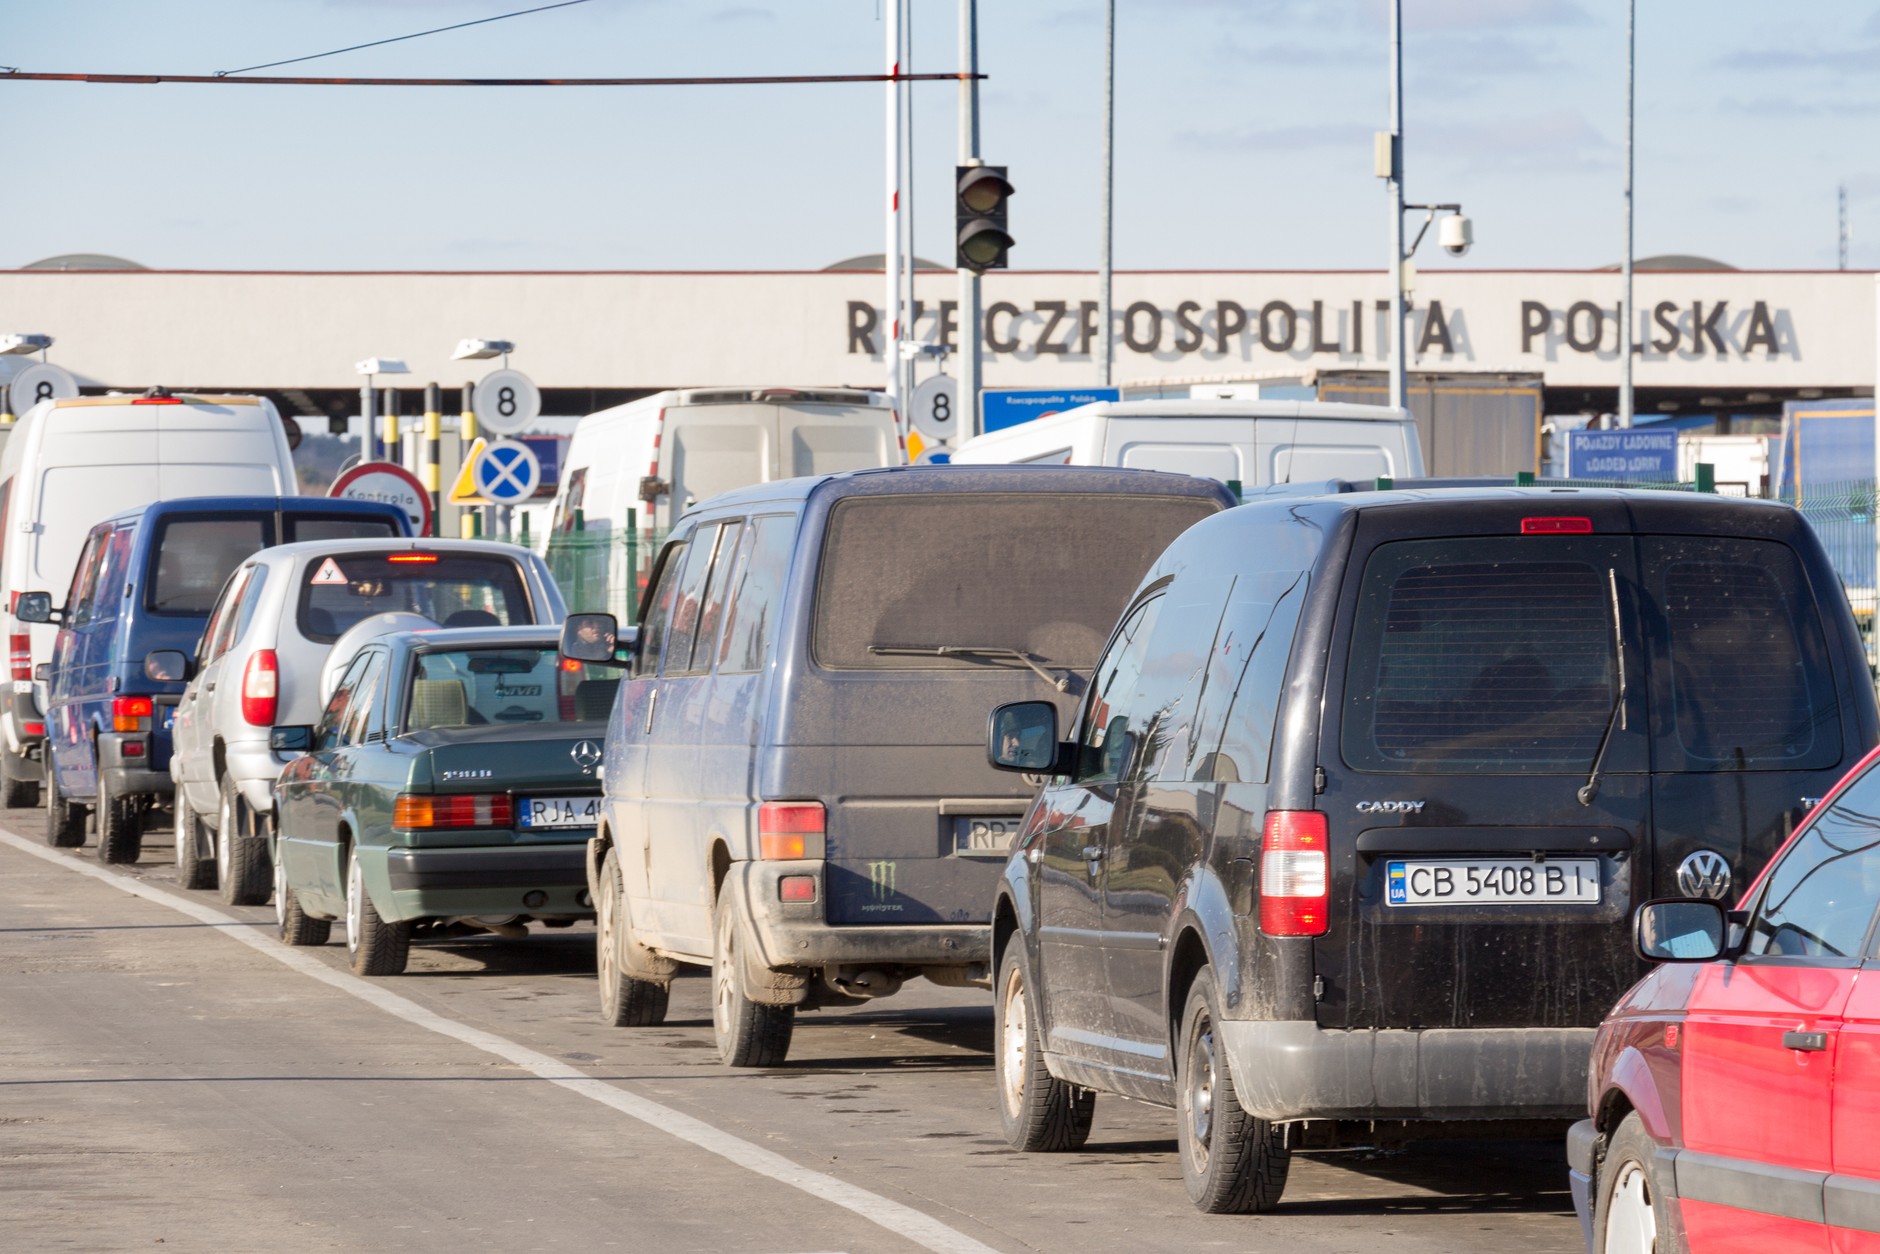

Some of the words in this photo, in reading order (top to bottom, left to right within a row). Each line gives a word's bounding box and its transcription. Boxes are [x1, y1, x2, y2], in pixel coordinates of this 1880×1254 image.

[847, 299, 1454, 354] RECZPOSPOLIA
[498, 386, 516, 417] 8
[932, 393, 950, 422] 8
[1586, 456, 1626, 471] LOADED
[1628, 456, 1662, 470] LORRY
[347, 488, 414, 505] Kontrola
[533, 801, 576, 822] RJA
[584, 799, 601, 821] 4
[1355, 801, 1426, 814] CADDY
[1410, 868, 1455, 897] CB
[1466, 866, 1536, 896] 5408
[1390, 888, 1406, 899] UA
[861, 904, 904, 912] MONSTER
